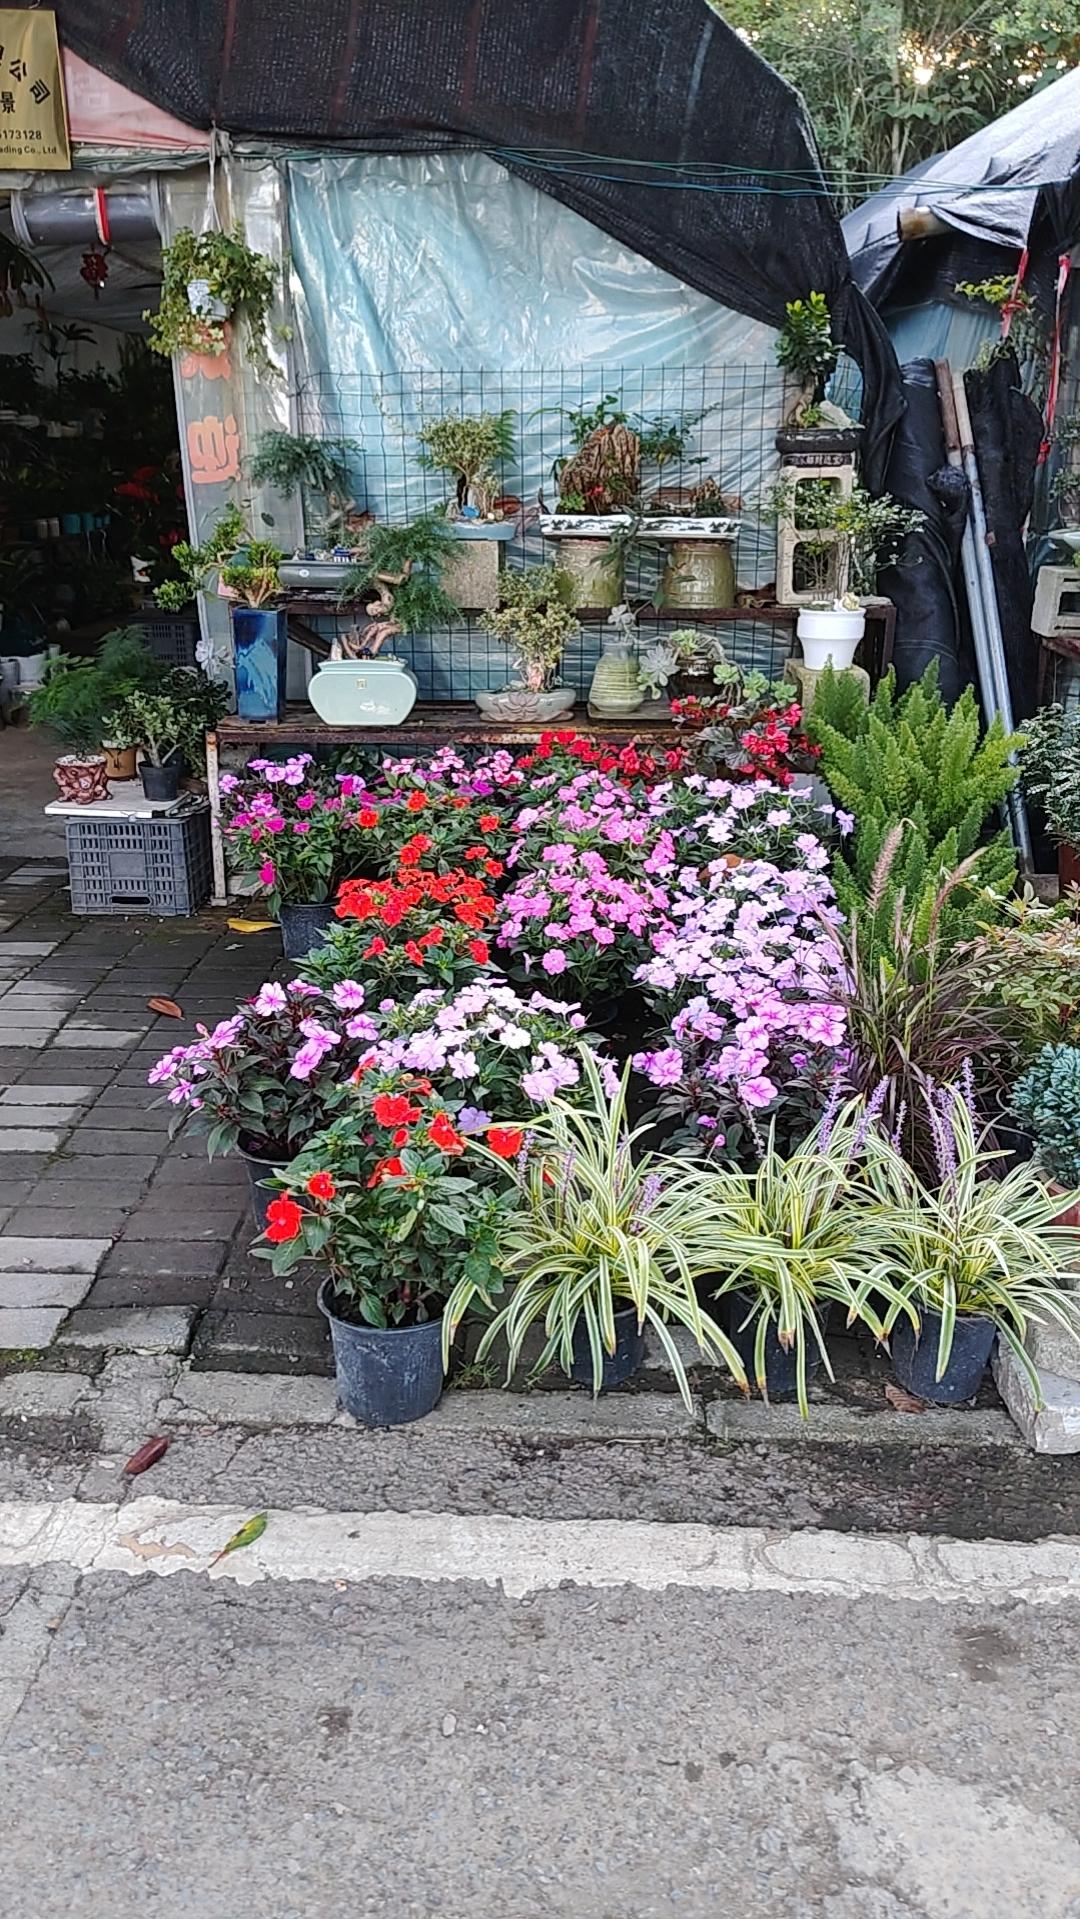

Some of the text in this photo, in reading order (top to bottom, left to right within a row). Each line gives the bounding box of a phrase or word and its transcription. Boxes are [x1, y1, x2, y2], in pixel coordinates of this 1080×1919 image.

[0, 44, 51, 104] 公司
[1, 91, 16, 113] 景
[0, 130, 42, 140] 173128
[43, 146, 57, 154] Ltd
